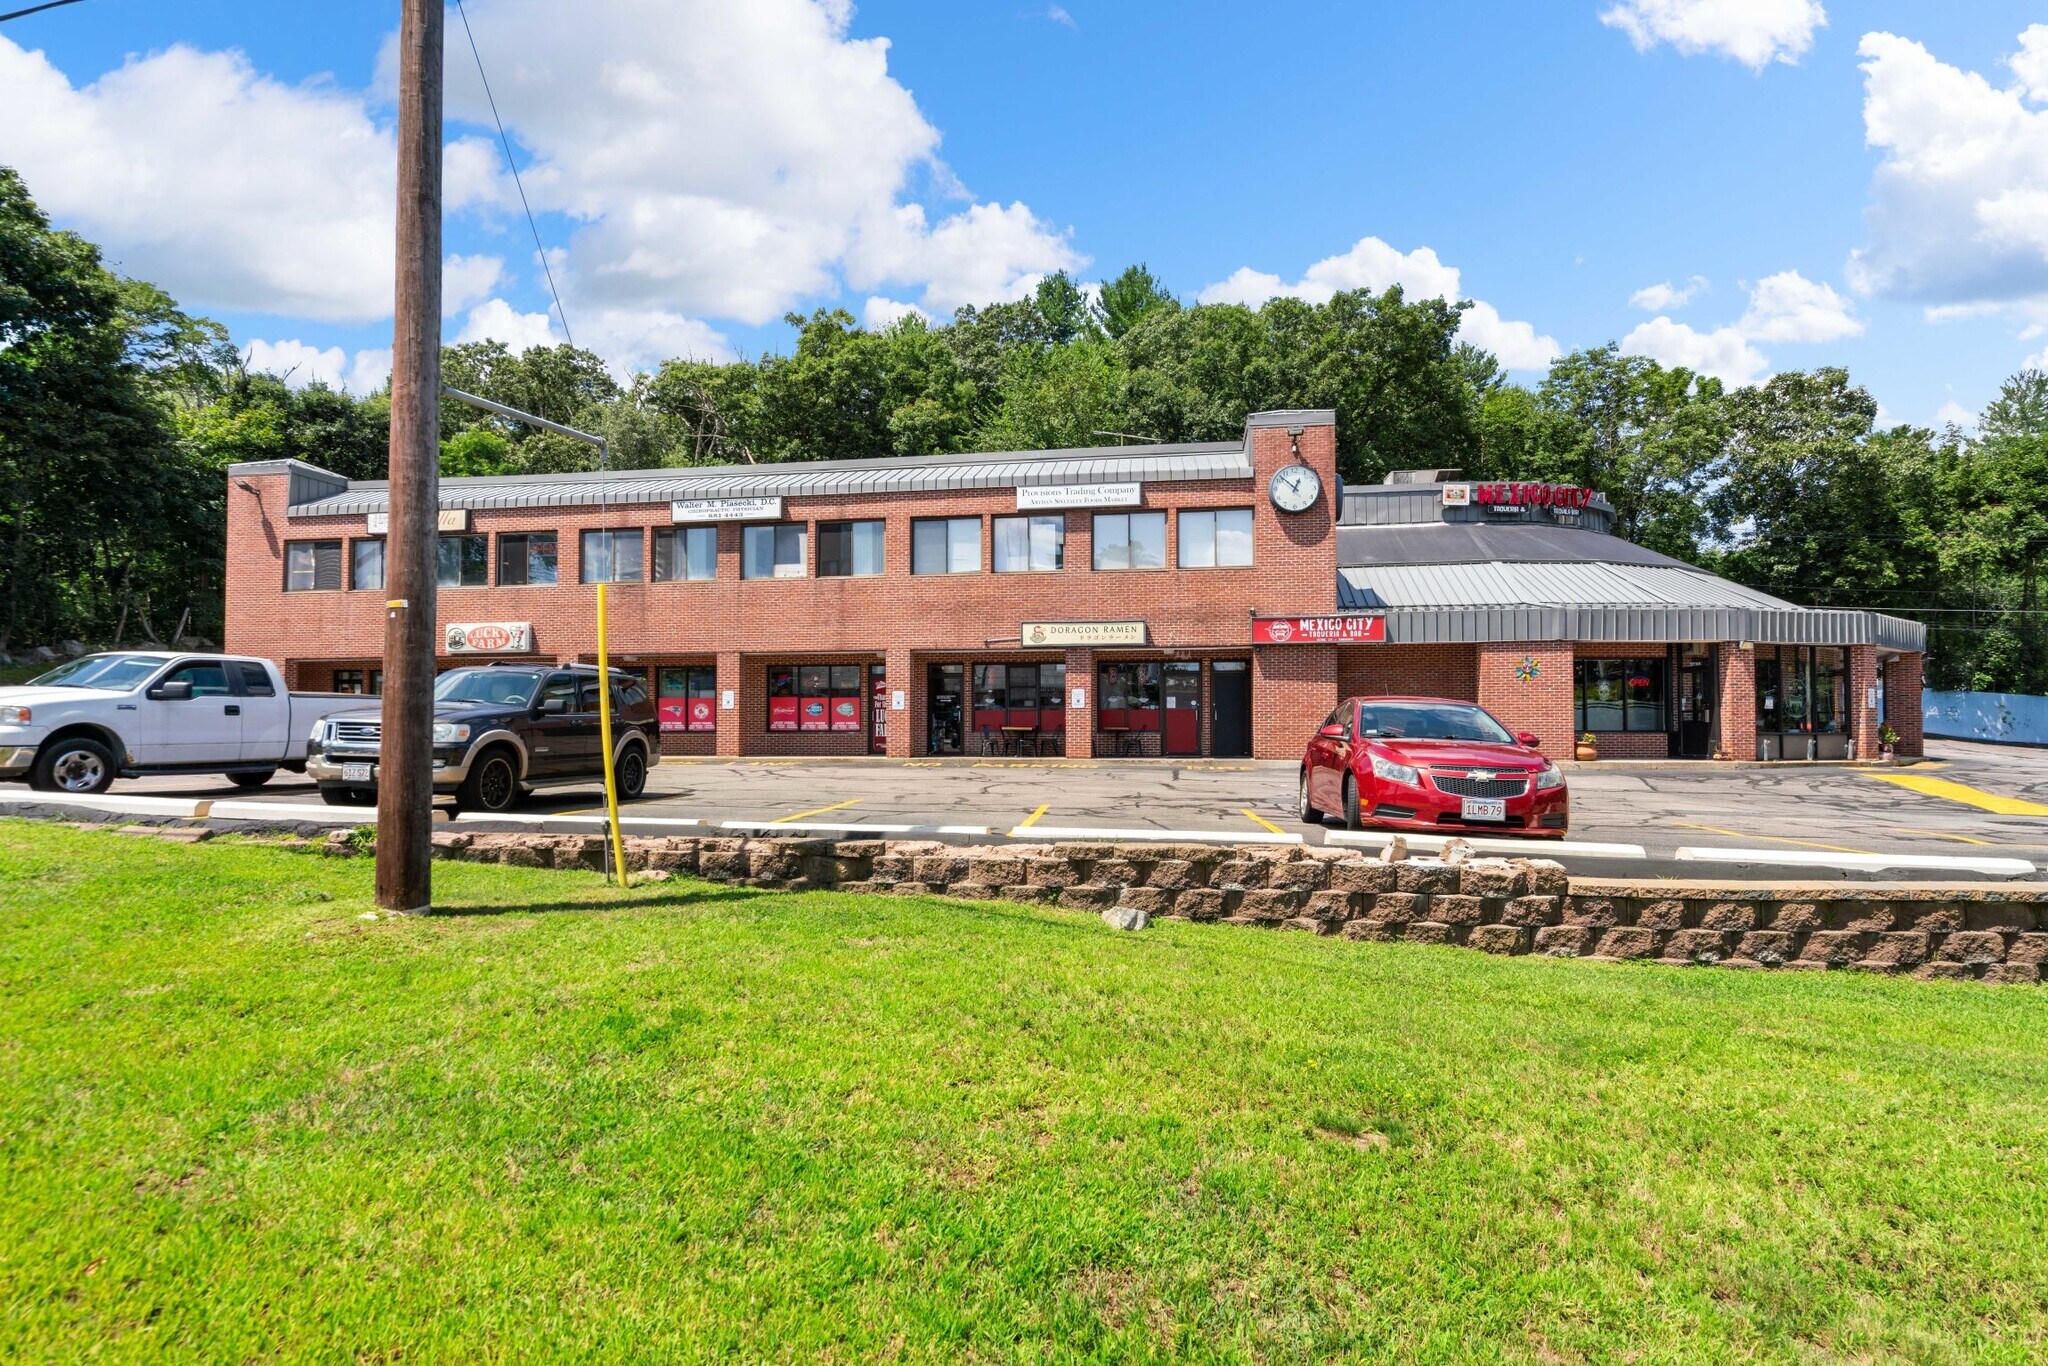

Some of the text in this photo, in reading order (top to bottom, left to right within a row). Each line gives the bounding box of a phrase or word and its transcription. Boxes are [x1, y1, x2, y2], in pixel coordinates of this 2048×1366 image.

[1022, 486, 1135, 497] Provisions Trading Company
[1477, 483, 1592, 508] MEXICO CITY
[676, 500, 703, 509] Walter
[707, 500, 717, 508] M.
[761, 498, 776, 506] D.C.
[1300, 617, 1374, 631] MEXICO CITY
[470, 628, 507, 638] LUCKY
[1050, 626, 1098, 634] DORAGON
[471, 637, 506, 648] FARM
[1630, 678, 1650, 687] OPEN
[1466, 805, 1502, 816] 1LMB 79
